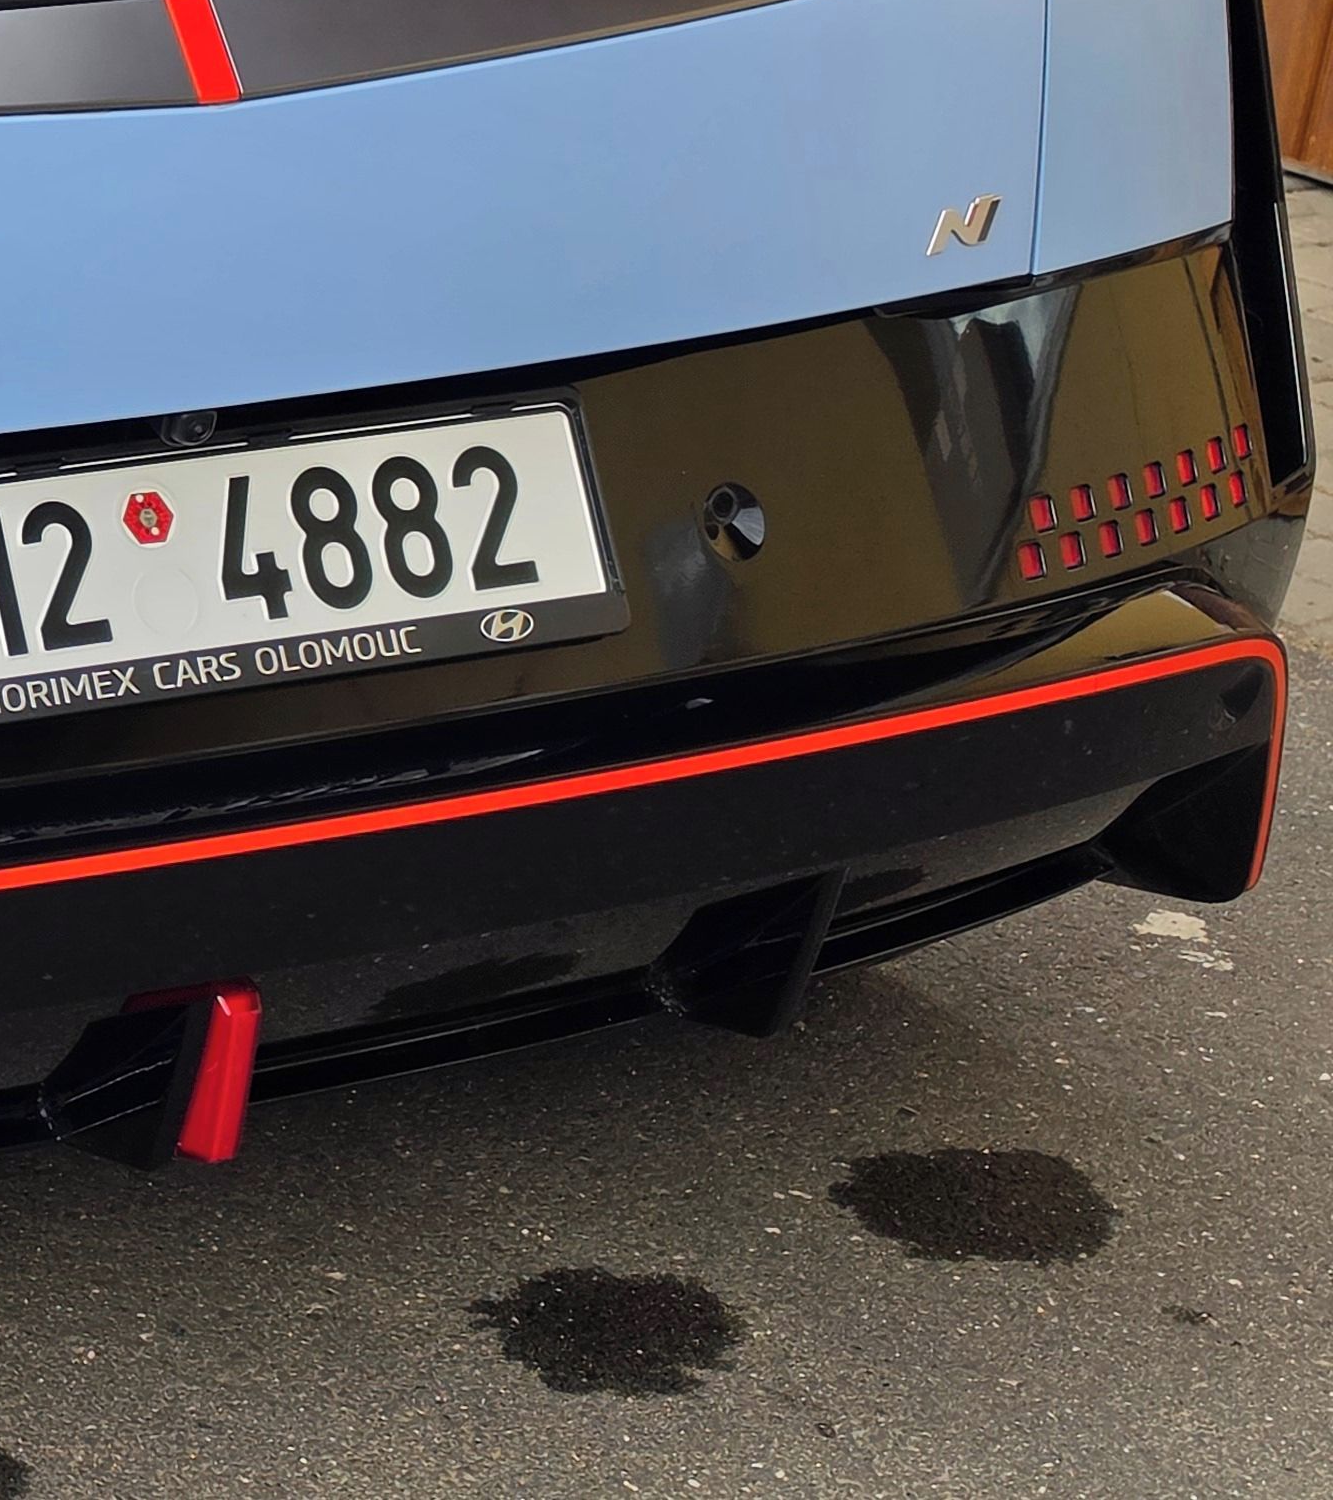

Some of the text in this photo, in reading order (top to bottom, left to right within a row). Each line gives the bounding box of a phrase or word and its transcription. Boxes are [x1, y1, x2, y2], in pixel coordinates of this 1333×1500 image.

[925, 193, 1002, 256] N
[221, 445, 540, 621] 4882
[151, 651, 243, 691] CARS
[253, 625, 423, 677] OLOMOUC
